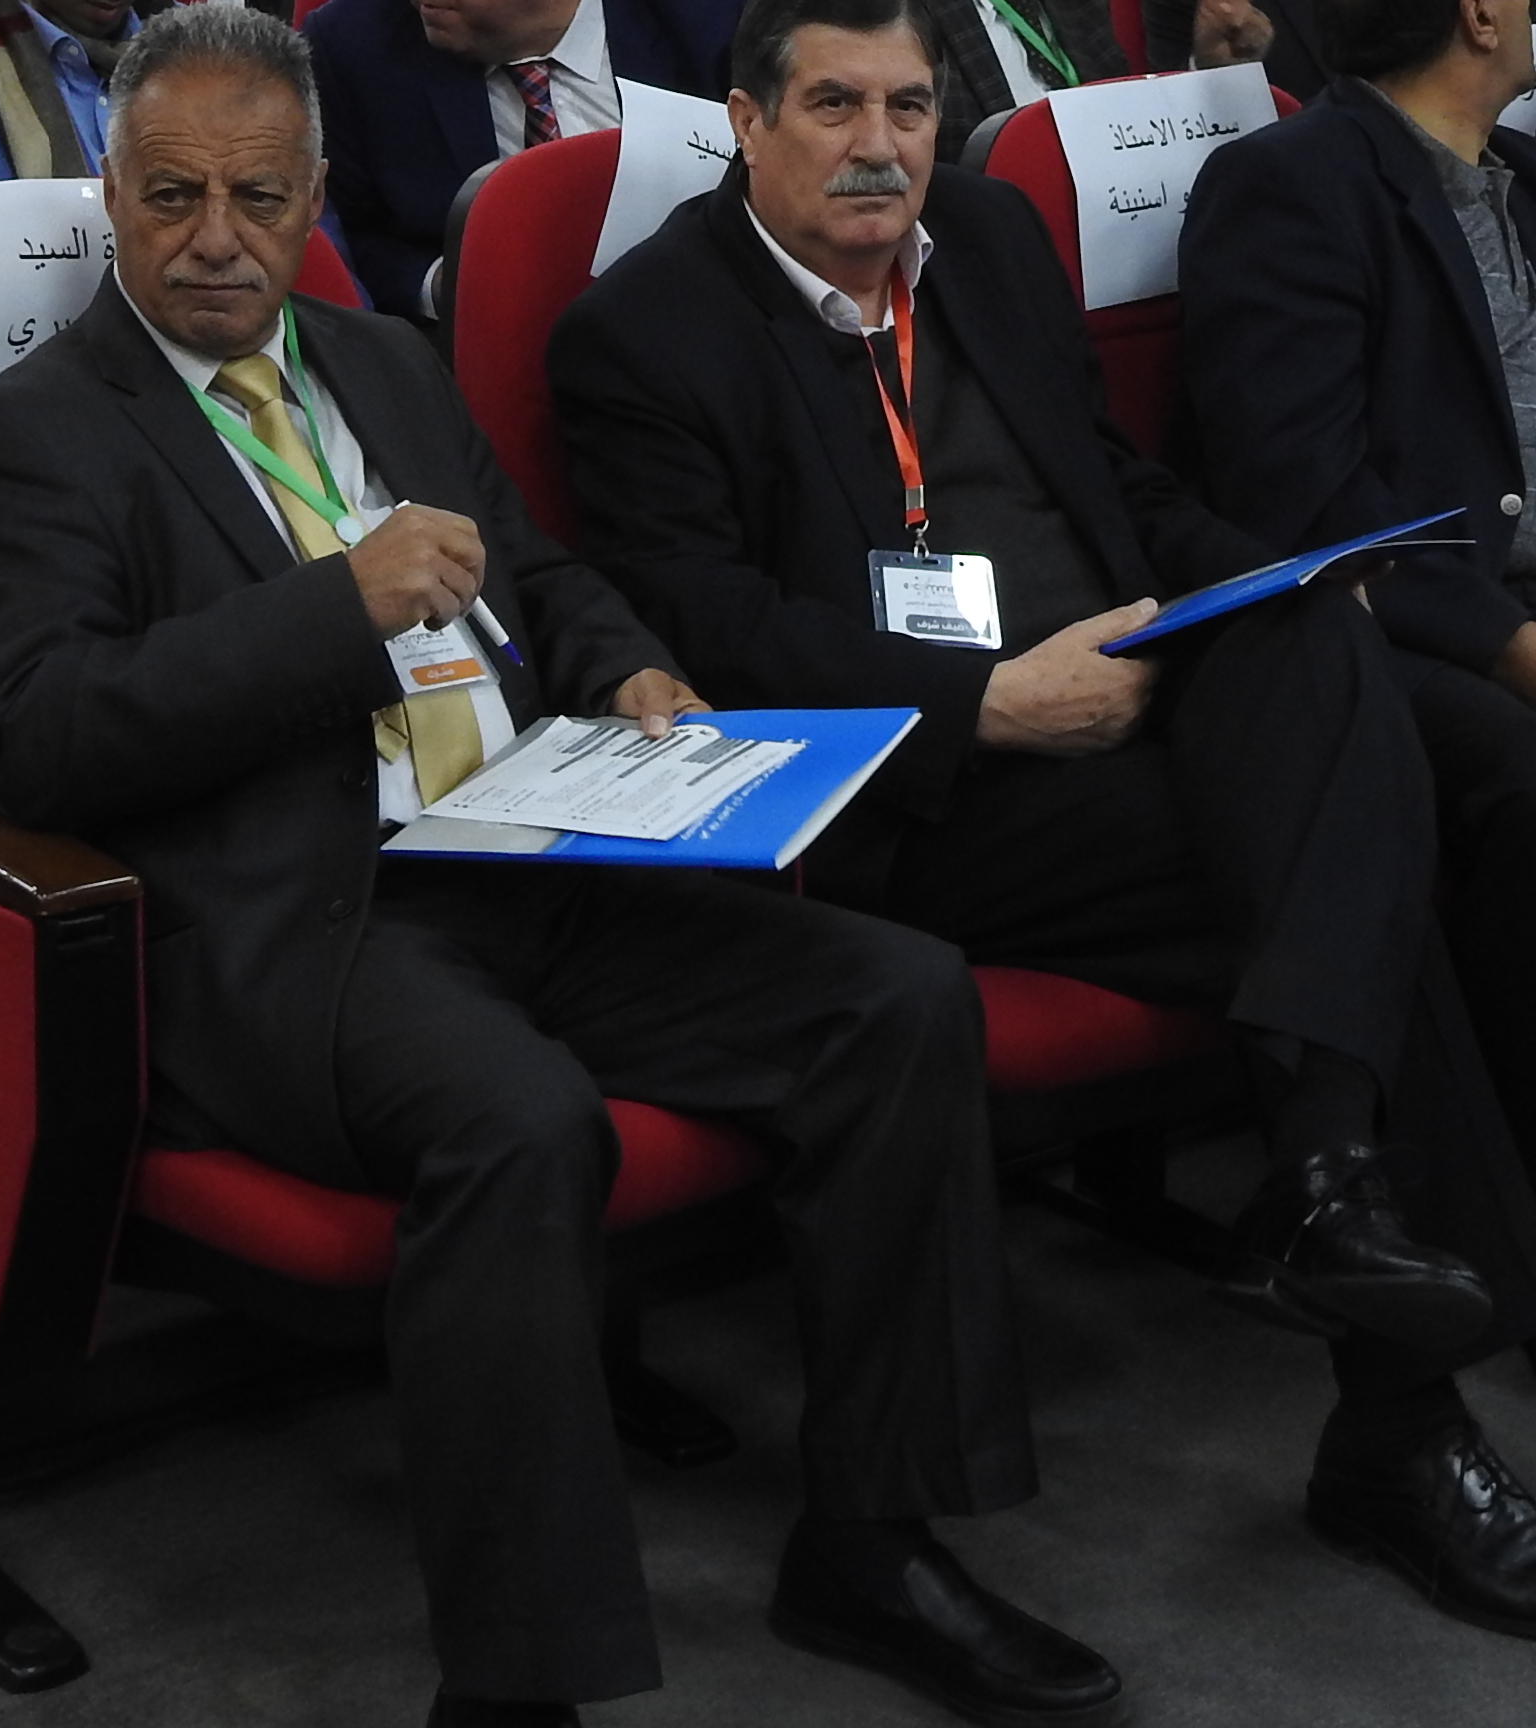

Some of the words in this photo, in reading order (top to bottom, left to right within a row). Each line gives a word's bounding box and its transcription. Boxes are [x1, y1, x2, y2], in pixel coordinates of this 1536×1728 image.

[1109, 117, 1177, 151] الاستاذ
[1182, 112, 1240, 141] سعادة
[686, 130, 732, 162] سيد
[1108, 181, 1168, 221] اسنينة
[19, 226, 89, 270] السيد
